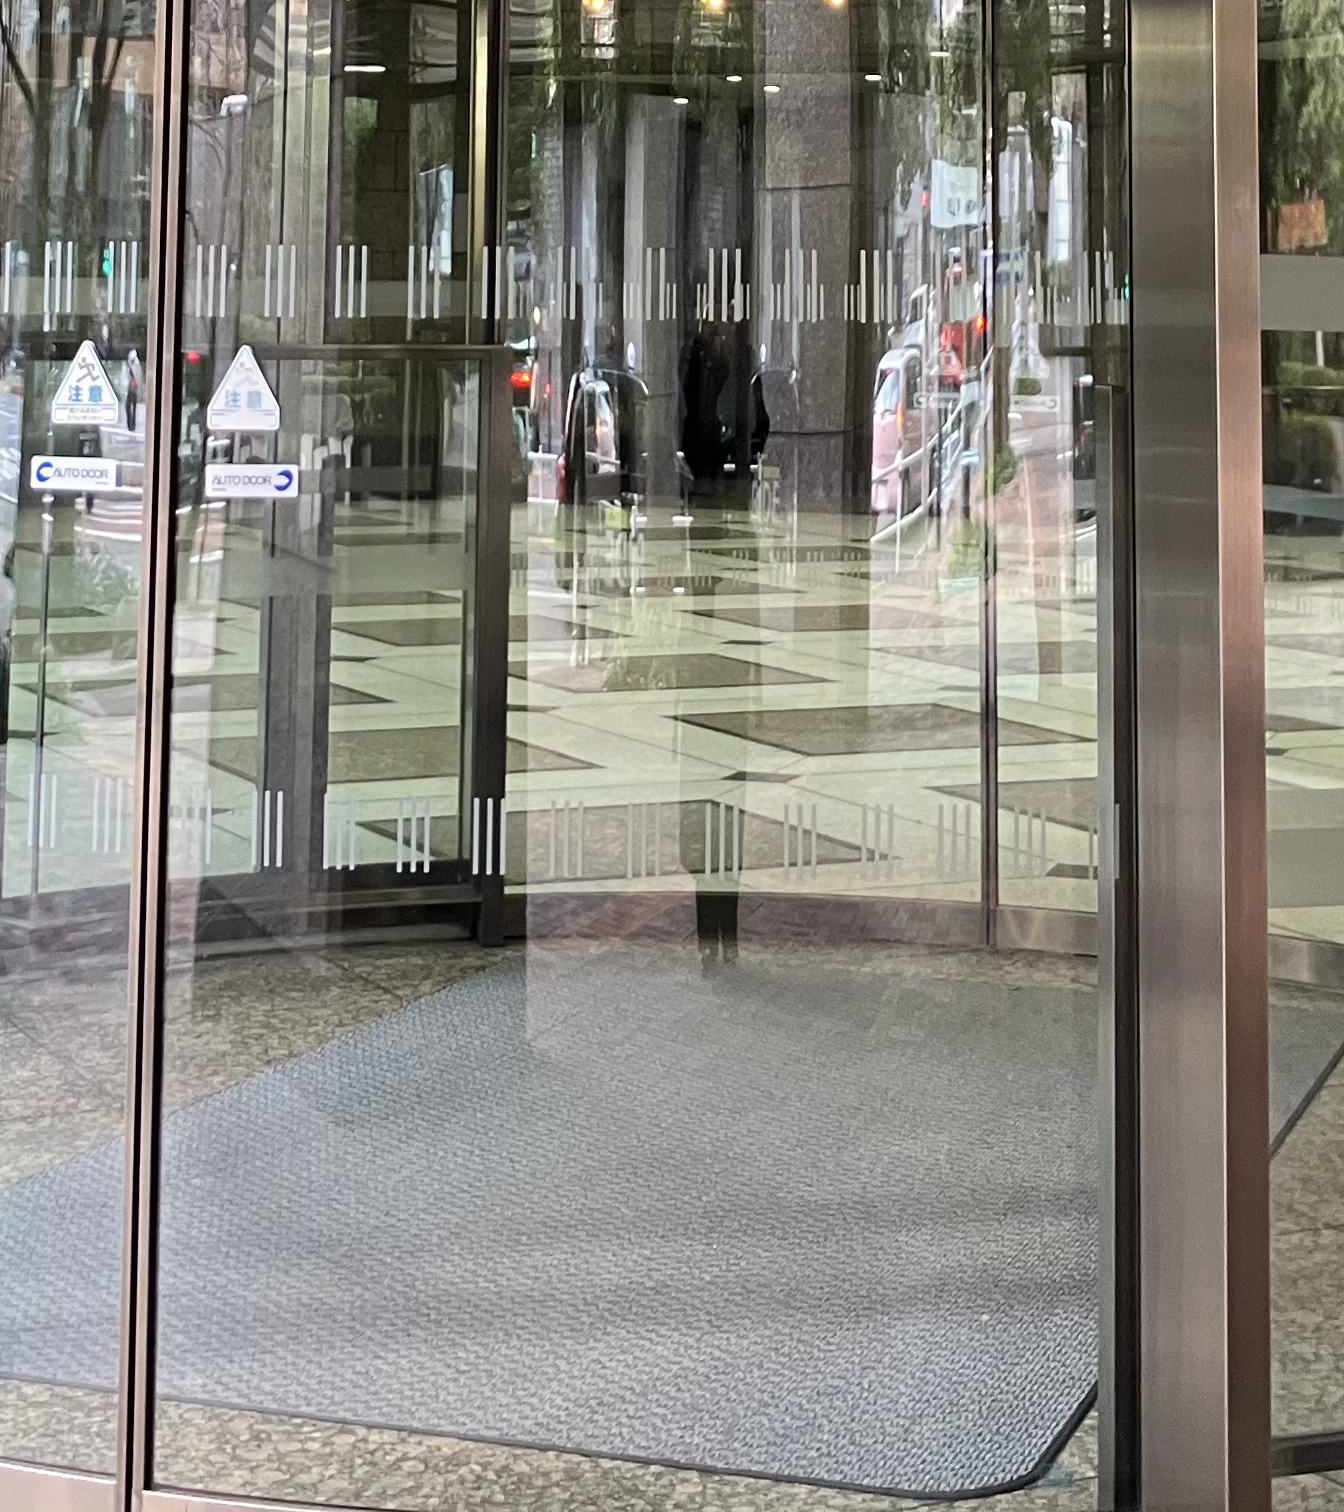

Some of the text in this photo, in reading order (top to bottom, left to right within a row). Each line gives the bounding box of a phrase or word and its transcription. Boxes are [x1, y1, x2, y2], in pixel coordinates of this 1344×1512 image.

[52, 467, 109, 479] AUTO DOOR
[212, 475, 272, 486] AUTO DOOR
